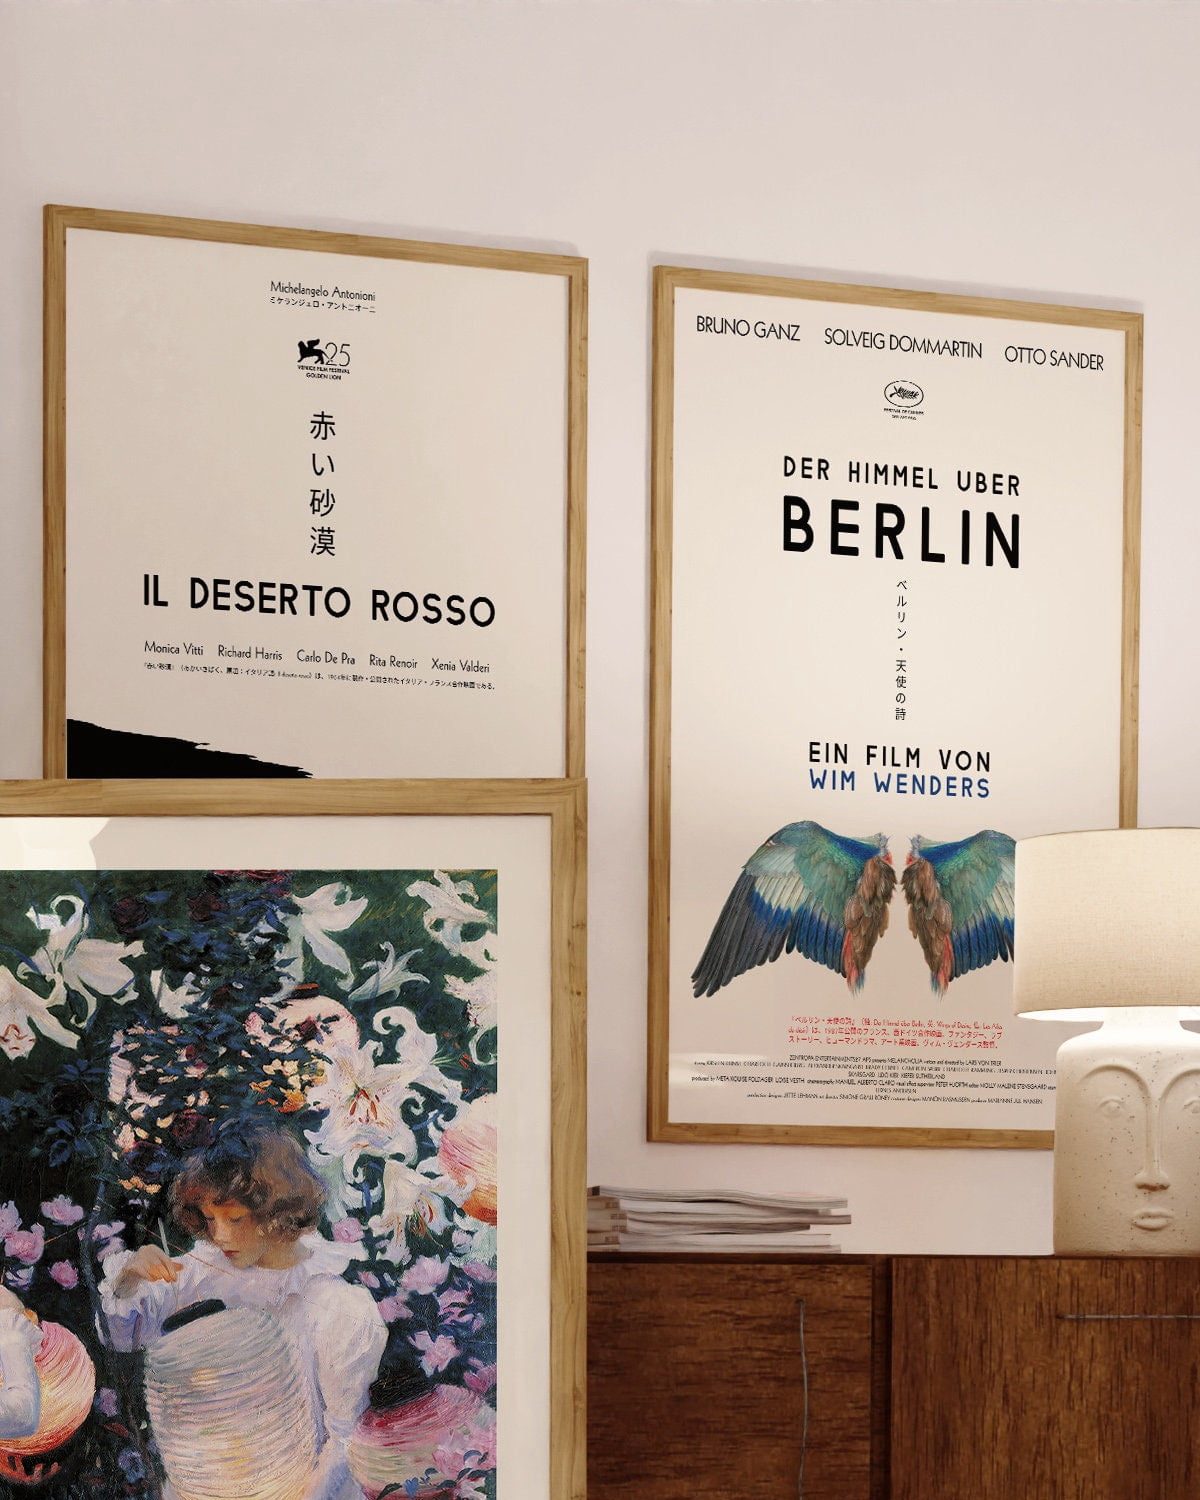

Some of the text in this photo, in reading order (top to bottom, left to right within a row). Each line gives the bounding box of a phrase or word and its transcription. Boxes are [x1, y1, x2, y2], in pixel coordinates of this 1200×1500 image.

[270, 281, 376, 302] Michelangelo Antonioni
[325, 342, 351, 367] 25
[697, 315, 1104, 371] BRUNO GANZ SOLVEIG DOMMARTIN OTTO SANDER
[310, 411, 337, 557] 赤い砂漠
[784, 456, 1019, 496] DER HIMMEL UBER
[783, 495, 1020, 569] BERLIN
[144, 574, 495, 627] IL DESERTO ROSSO
[144, 641, 490, 673] Monica Vitti Richard Harris Carlo De Pra Rita Renoir Xenia Valderi
[895, 580, 908, 721] ベルリン・天使の詩
[809, 742, 991, 772] EIN FILM VON
[809, 769, 990, 798] WIM WENDERS
